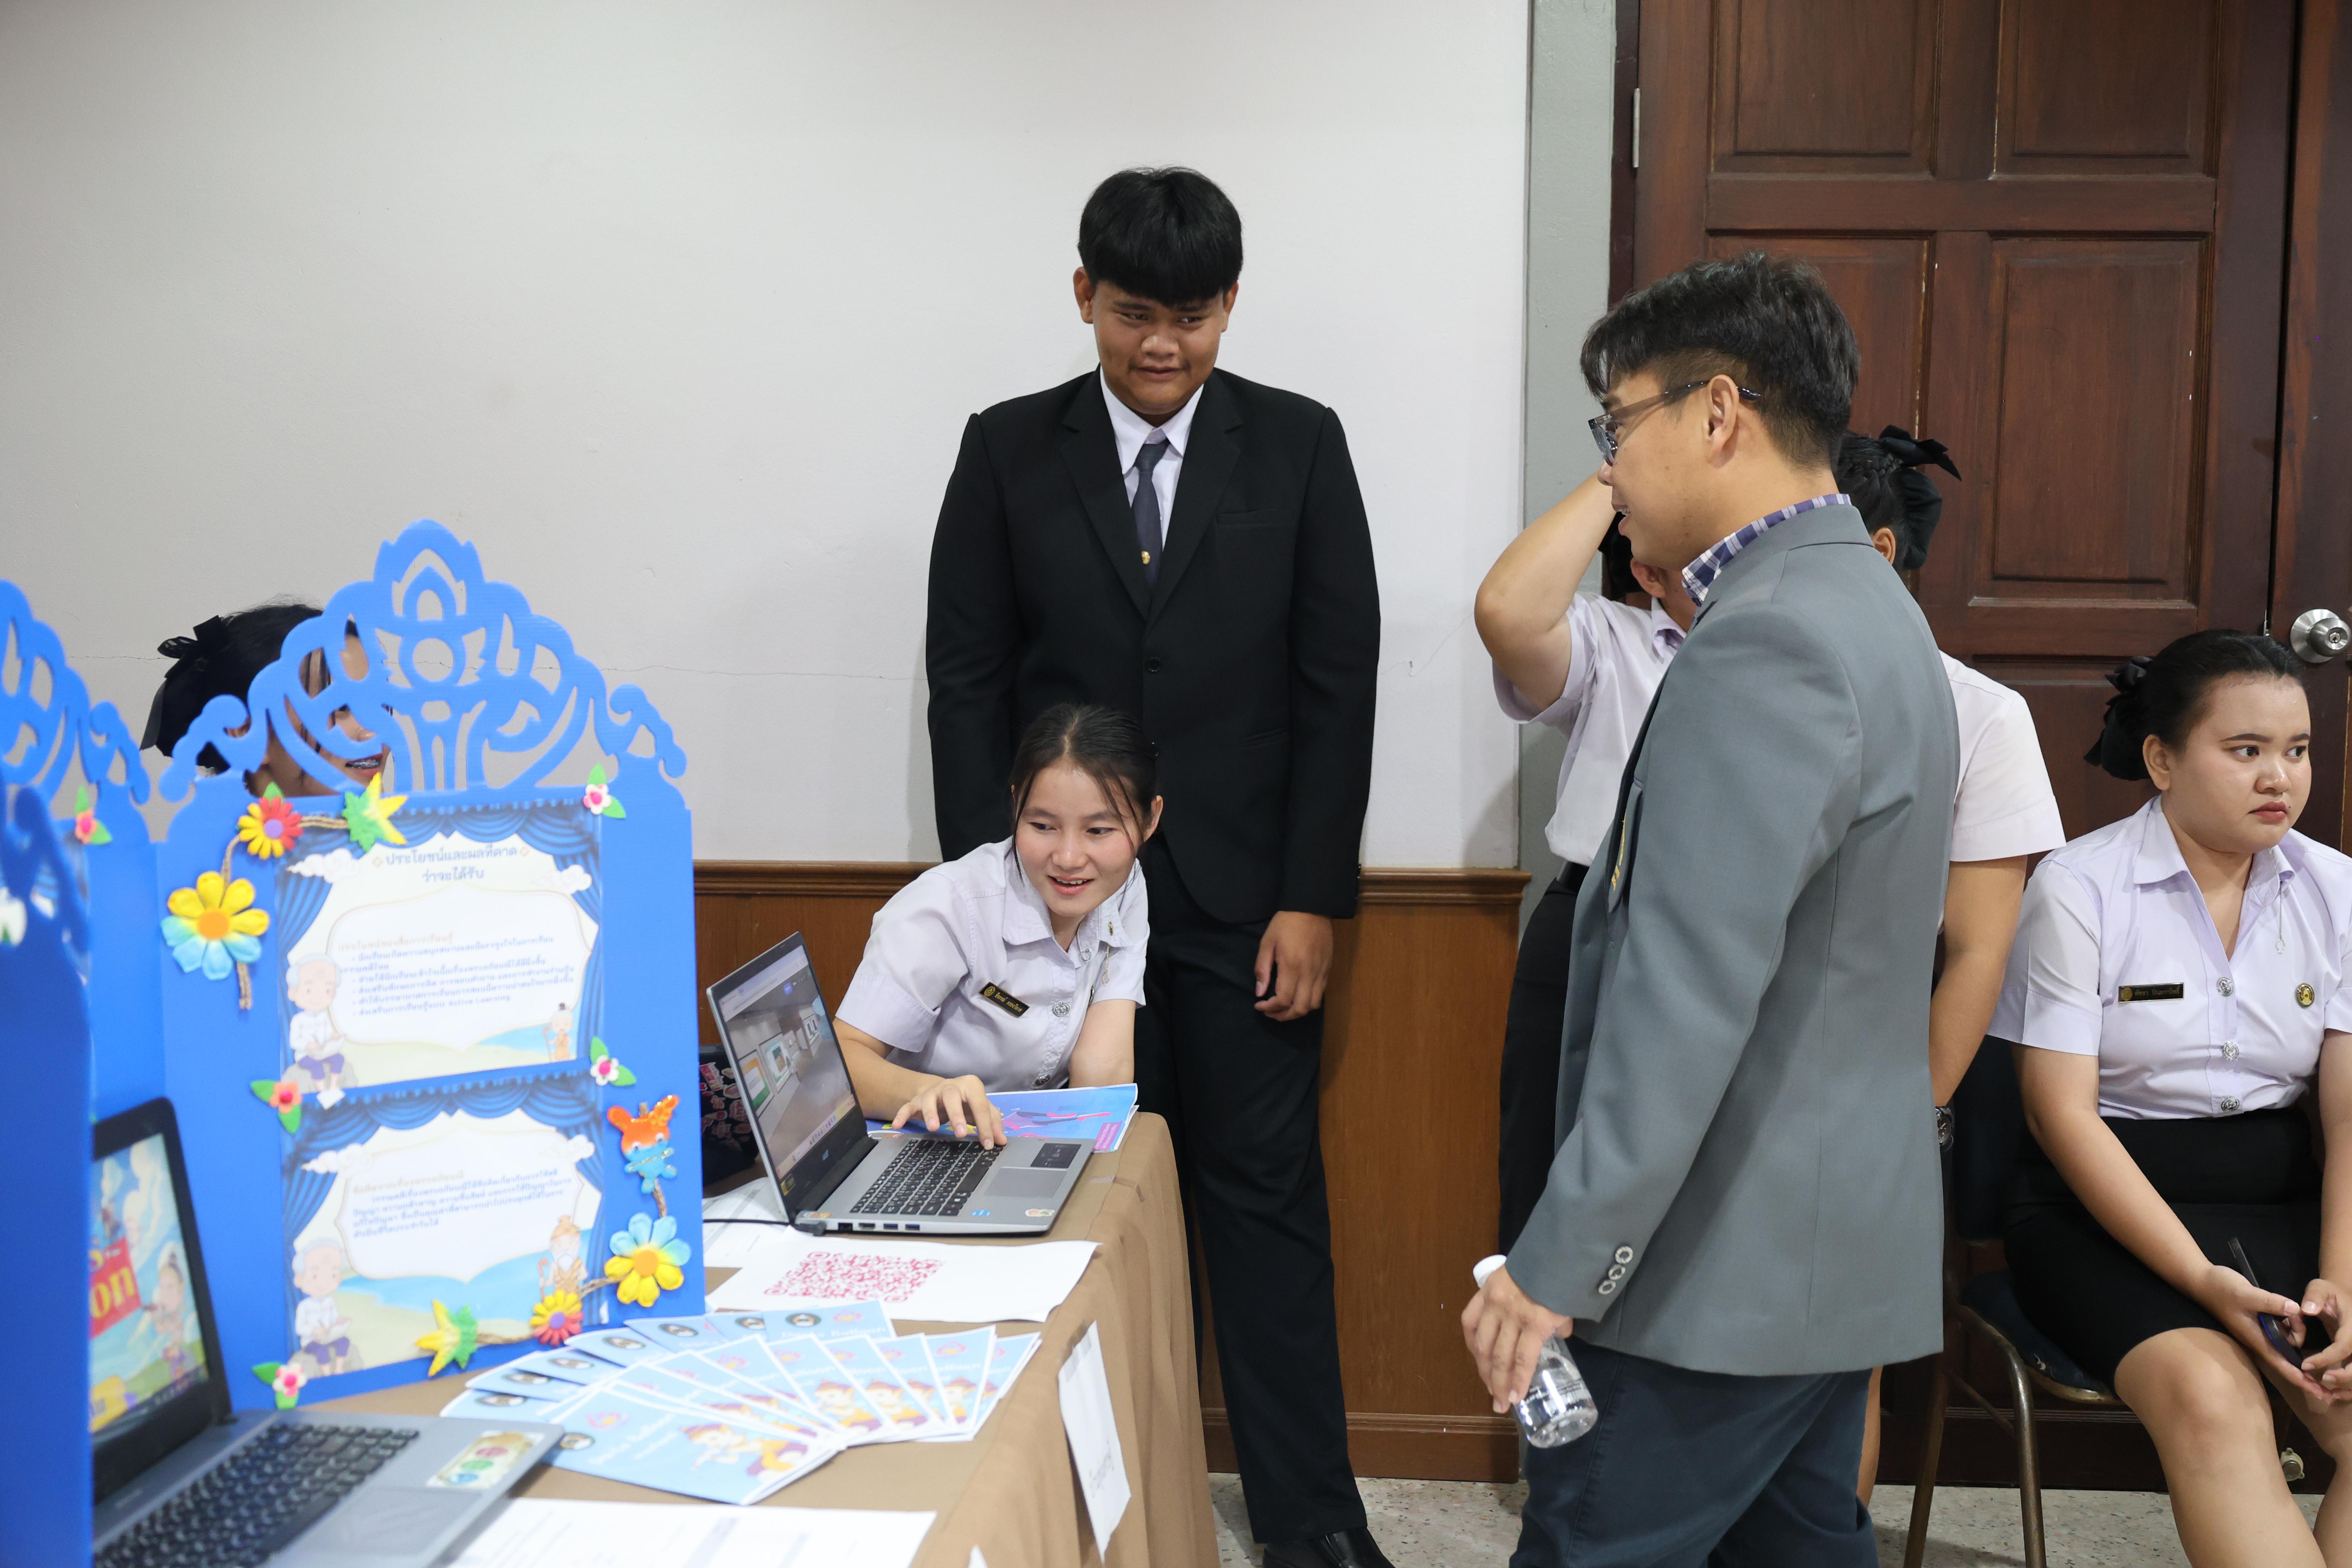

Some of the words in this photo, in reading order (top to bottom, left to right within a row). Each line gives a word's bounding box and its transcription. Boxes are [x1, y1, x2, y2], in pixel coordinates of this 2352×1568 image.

[386, 843, 517, 865] ประโยชน์และผลที่คาด
[422, 866, 484, 882] ว่าจะได้รับ
[475, 995, 510, 1004] Learning
